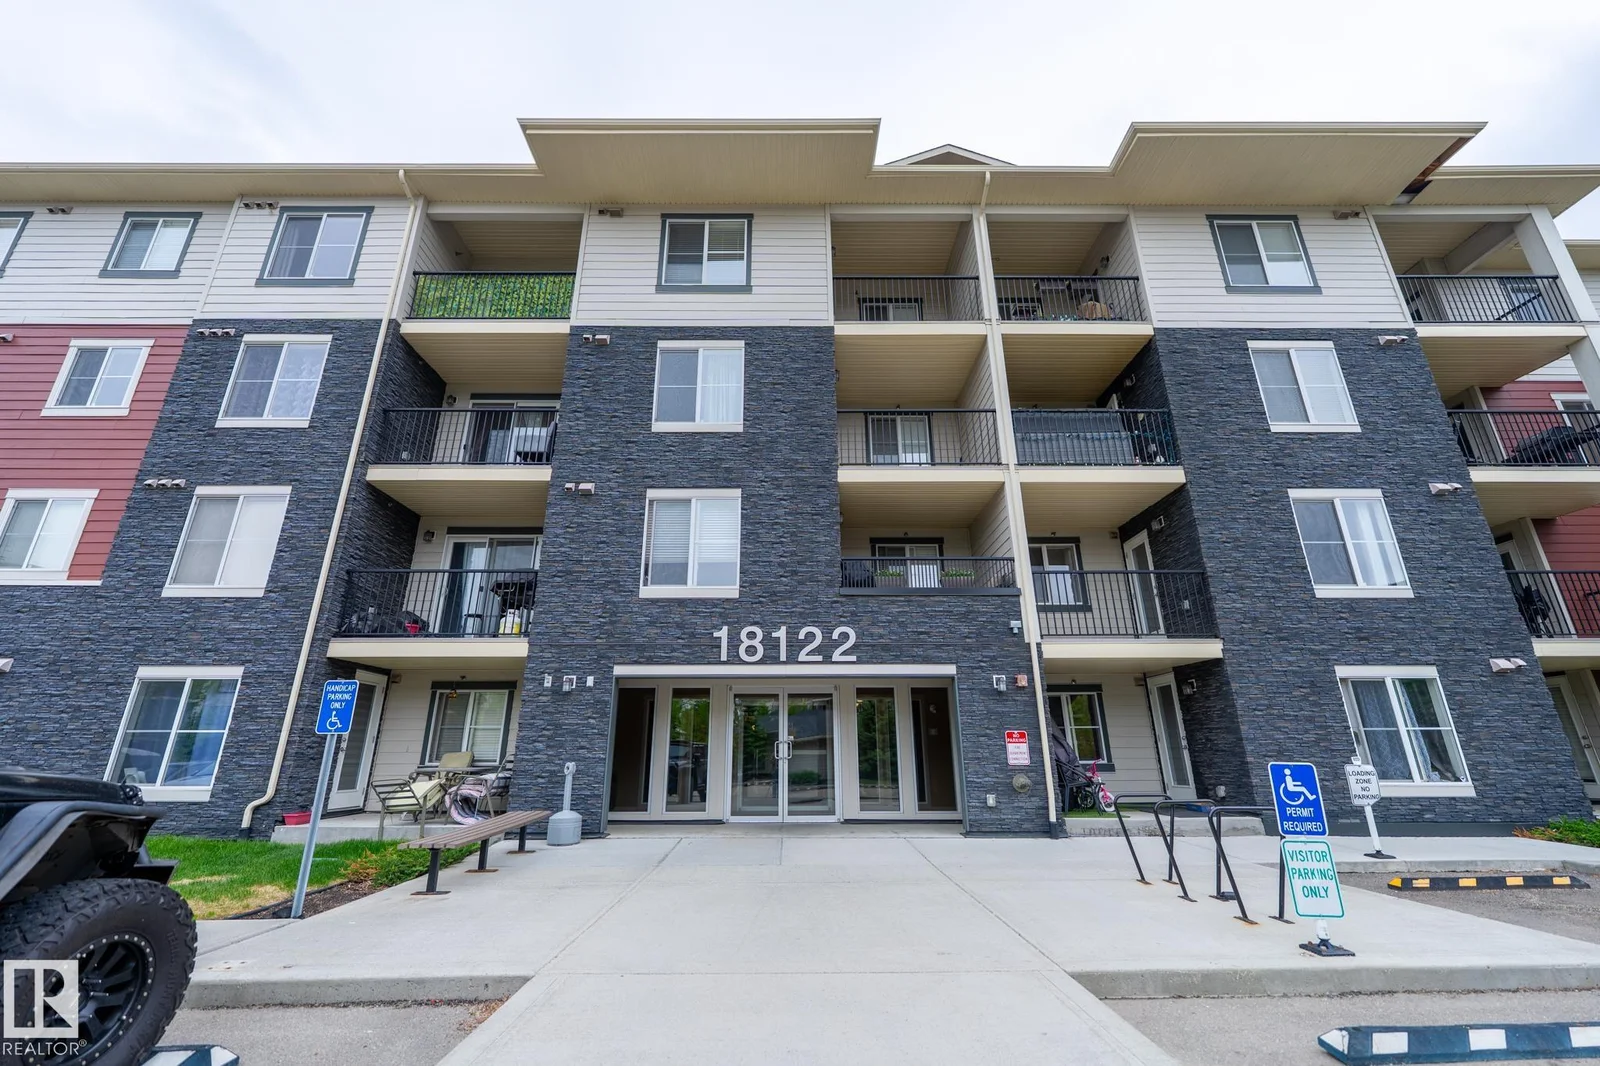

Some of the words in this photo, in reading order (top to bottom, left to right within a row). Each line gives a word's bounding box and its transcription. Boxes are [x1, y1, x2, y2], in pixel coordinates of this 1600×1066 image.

[713, 626, 857, 662] 18122
[330, 701, 346, 709] ONLY
[1286, 807, 1314, 817] PERMIT
[1283, 821, 1323, 832] REQUIRED
[1287, 850, 1329, 863] VISITOR
[1291, 868, 1334, 881] PARKING
[1302, 886, 1329, 899] ONLY
